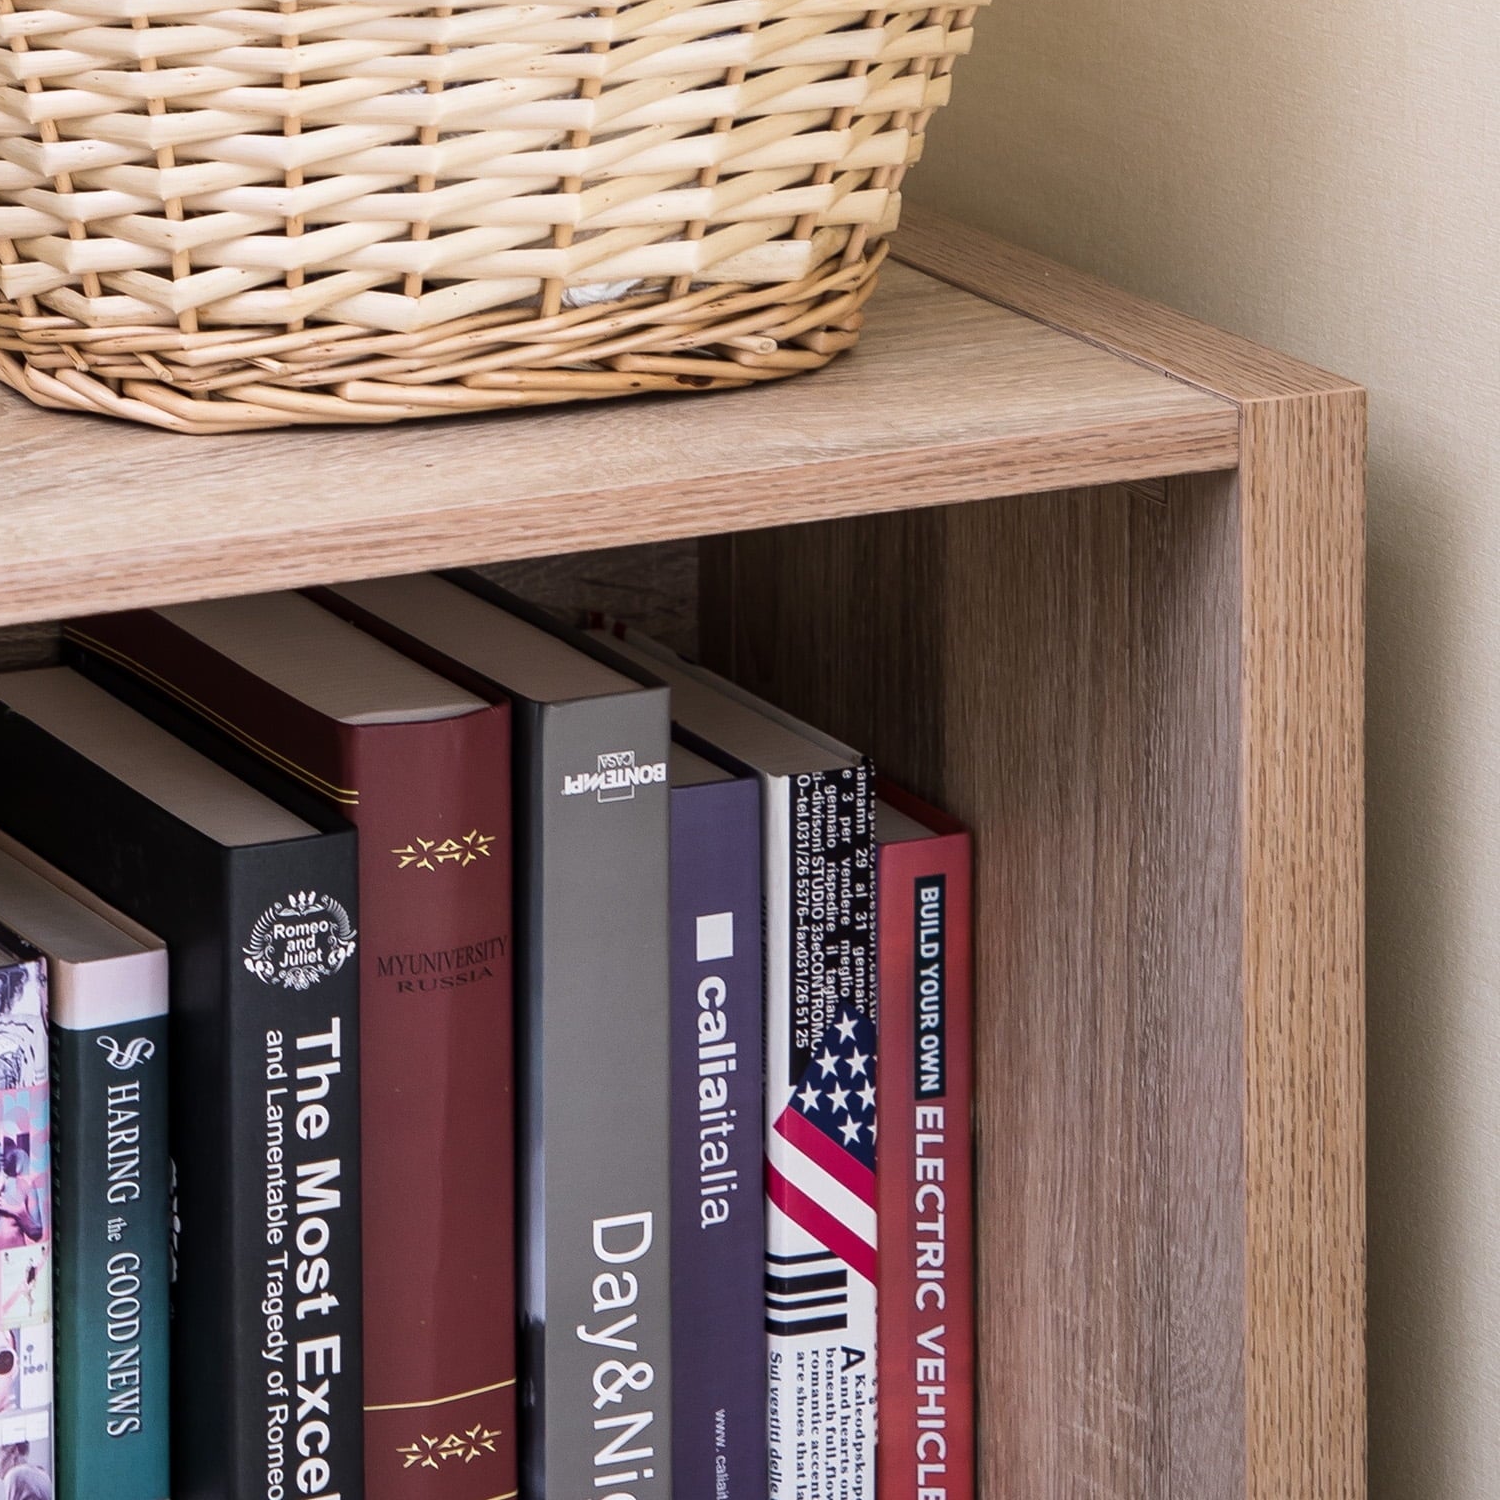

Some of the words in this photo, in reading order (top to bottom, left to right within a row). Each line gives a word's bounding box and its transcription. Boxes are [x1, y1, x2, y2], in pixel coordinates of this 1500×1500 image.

[563, 763, 666, 795] BONTEMPI
[841, 791, 854, 802] 3
[842, 769, 852, 779] e
[824, 784, 840, 848] gennaio
[839, 816, 852, 844] per
[855, 847, 868, 869] 29
[811, 855, 825, 920] STUDIO
[824, 861, 840, 932] rispedire
[840, 857, 854, 926] vendere
[855, 882, 868, 898] al
[273, 920, 329, 940] Romeo
[286, 934, 316, 952] and
[855, 911, 868, 931] 31
[921, 885, 940, 958] BUILD
[279, 948, 323, 968] Juliet
[825, 944, 839, 956] il
[838, 939, 853, 997] meglio
[397, 966, 493, 994] RUSSIA
[921, 962, 940, 1028] YOUR
[796, 1006, 810, 1025] 51
[796, 1029, 810, 1049] 25
[266, 1028, 288, 1080] and
[296, 1016, 341, 1141] The
[921, 1030, 940, 1092] OWN
[697, 975, 737, 1230] caliaitalia
[265, 1088, 288, 1245] Lamentable
[107, 1216, 130, 1242] the
[915, 1104, 945, 1312] ELECTRIC
[296, 1158, 341, 1320] Most
[106, 1251, 142, 1343] GOOD
[261, 1252, 289, 1364] Tragedy
[576, 1211, 654, 1500] Day&Ni
[796, 1352, 806, 1381] are
[841, 1346, 866, 1372] A
[106, 1344, 142, 1439] NEWS
[267, 1370, 289, 1397] of
[811, 1349, 822, 1436] romantic
[825, 1347, 837, 1421] beneath
[840, 1375, 851, 1410] and
[296, 1334, 341, 1500] Exce
[796, 1386, 807, 1437] shoes
[916, 1324, 947, 1500] VEHICLE
[267, 1403, 289, 1500] Romeo
[770, 1448, 783, 1493] delle
[796, 1442, 807, 1480] that
[840, 1415, 851, 1475] hearts
